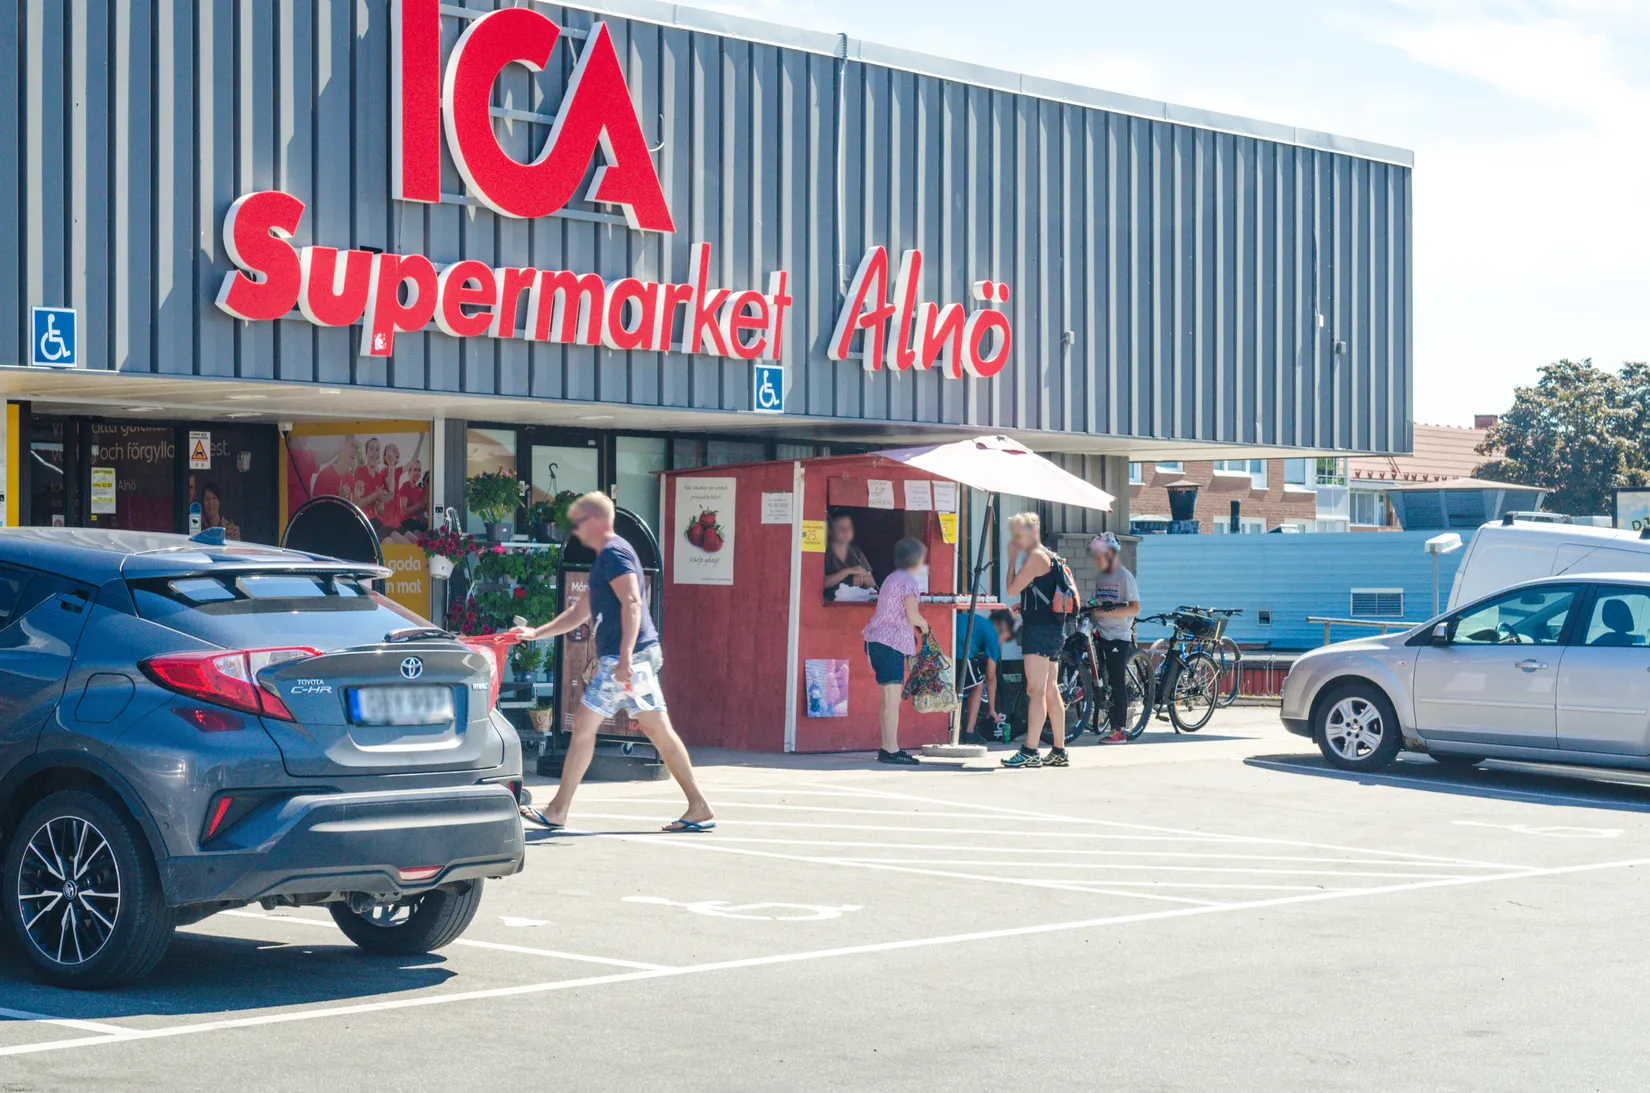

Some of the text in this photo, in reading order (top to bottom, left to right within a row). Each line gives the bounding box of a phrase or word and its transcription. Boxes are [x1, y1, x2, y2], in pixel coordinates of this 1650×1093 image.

[391, 0, 676, 233] ICA
[215, 190, 1011, 380] Supermarket Alnö
[100, 443, 124, 460] och
[210, 440, 231, 456] est.
[117, 480, 137, 492] Alnö
[388, 556, 421, 574] goda
[689, 556, 704, 566] Varje
[397, 579, 422, 593] mat
[290, 686, 333, 694] C-HR
